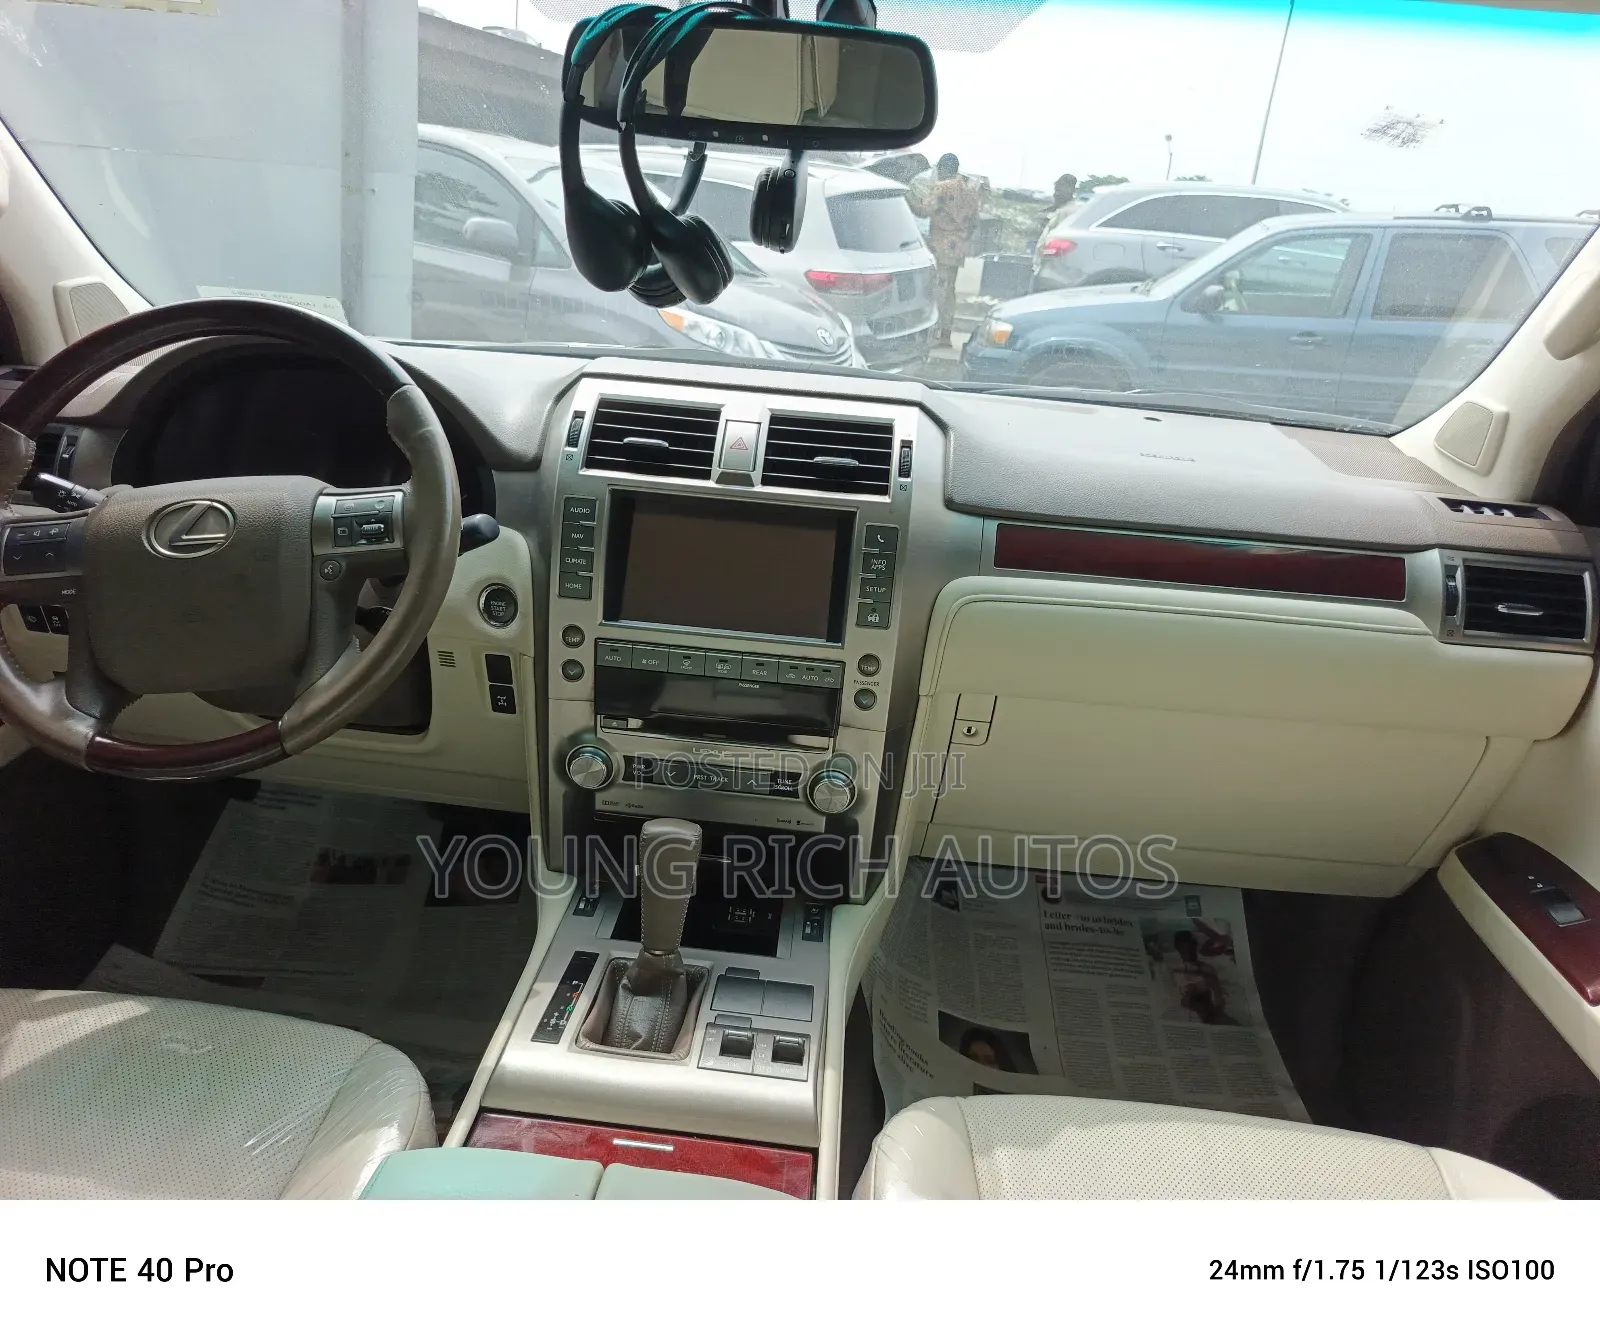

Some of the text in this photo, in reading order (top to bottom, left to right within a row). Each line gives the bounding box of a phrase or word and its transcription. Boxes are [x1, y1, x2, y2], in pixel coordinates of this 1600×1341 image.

[570, 506, 591, 514] AUDIO
[565, 556, 587, 566] CLIMATE
[870, 564, 886, 572] APPS
[564, 582, 582, 590] HOME
[61, 588, 77, 596] MODE
[604, 654, 622, 662] AUTO
[860, 664, 876, 672] TEMP
[752, 669, 768, 677] REAR
[802, 674, 819, 682] AUTO
[1044, 910, 1073, 920] Letter
[1103, 915, 1134, 928] brides
[1044, 921, 1062, 930] and
[896, 1053, 914, 1074] alive
